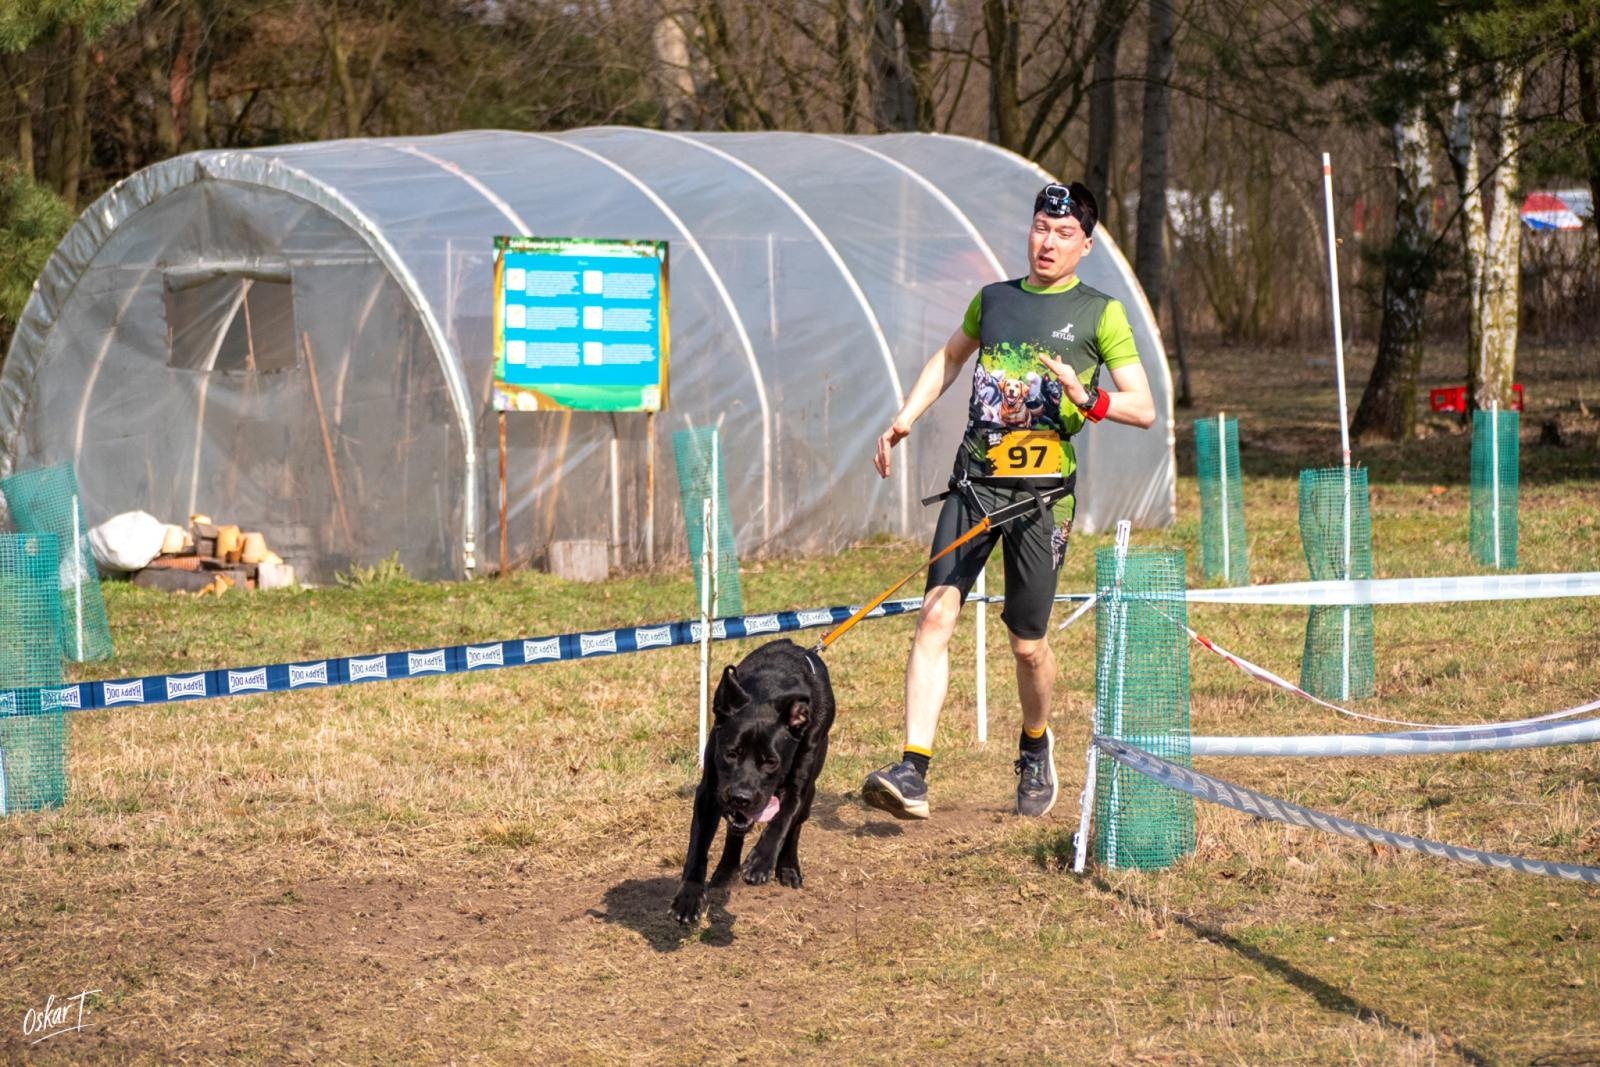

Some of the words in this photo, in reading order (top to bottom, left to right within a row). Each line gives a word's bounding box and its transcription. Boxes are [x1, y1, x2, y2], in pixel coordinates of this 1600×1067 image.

[1051, 330, 1075, 342] SKYLOS
[1008, 445, 1048, 468] 97
[637, 632, 650, 644] DOG
[650, 629, 669, 641] HAPPY
[539, 642, 558, 654] HAPPY
[582, 639, 594, 651] DOG
[595, 636, 615, 648] HAPPY
[468, 651, 481, 663] DOG
[482, 648, 501, 660] HAPPY
[525, 645, 538, 657] DOG
[365, 660, 385, 672] HAPPY
[410, 658, 423, 669] DOG
[424, 654, 444, 667] HAPPY
[305, 667, 326, 679] HAPPY
[351, 664, 363, 675] DOG
[230, 676, 243, 687] DOG
[244, 673, 265, 685] HAPPY
[291, 670, 304, 682] DOG
[120, 684, 142, 697] HAPPY
[169, 682, 182, 694] DOG
[183, 678, 204, 691] HAPPY
[106, 687, 120, 700] DOG
